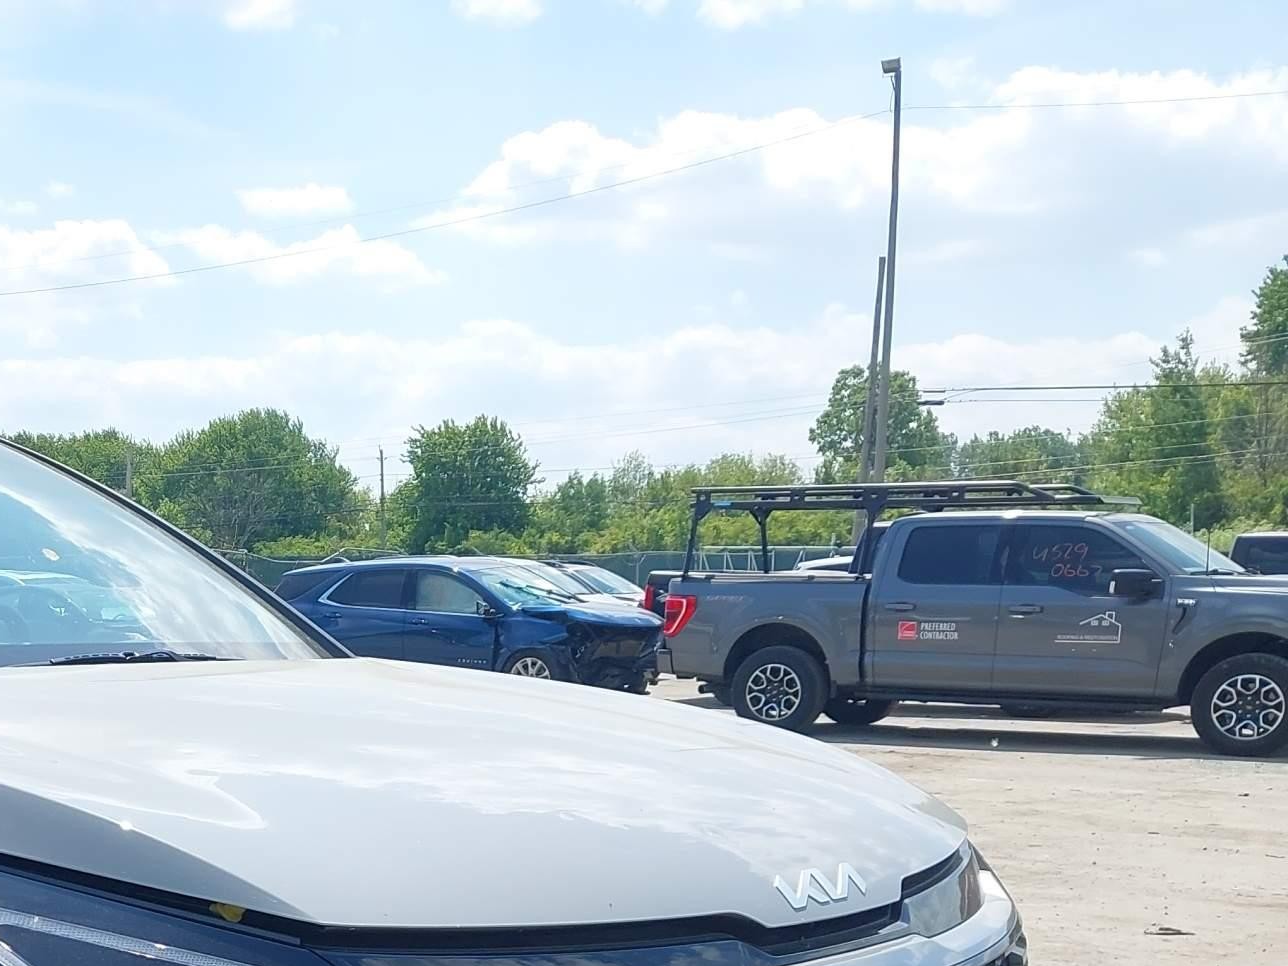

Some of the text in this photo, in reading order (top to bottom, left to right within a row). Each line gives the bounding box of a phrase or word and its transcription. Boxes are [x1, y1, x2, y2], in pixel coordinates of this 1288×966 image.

[920, 622, 956, 631] PREFERRED
[919, 631, 959, 640] CONTRACTOR
[773, 862, 866, 912] KIA
